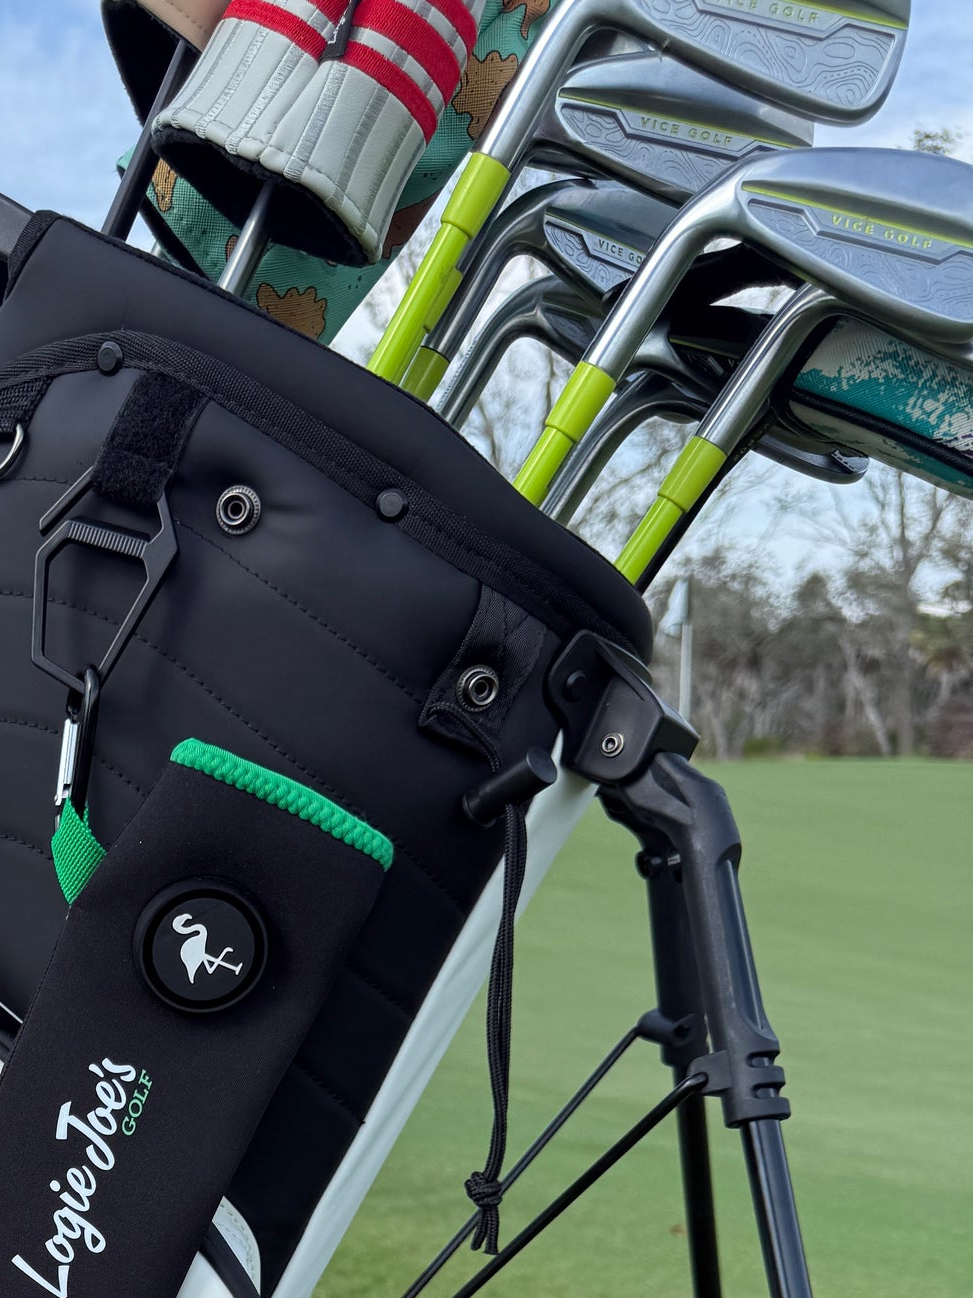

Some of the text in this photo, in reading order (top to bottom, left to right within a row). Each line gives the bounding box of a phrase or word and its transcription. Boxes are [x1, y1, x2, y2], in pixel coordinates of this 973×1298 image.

[769, 3, 819, 24] GOLF
[640, 116, 733, 146] VICE GOLF
[832, 215, 932, 249] VICE GOLF
[598, 238, 643, 265] VICE GO
[55, 1057, 137, 1171] Joe's
[121, 1069, 153, 1137] GOLF
